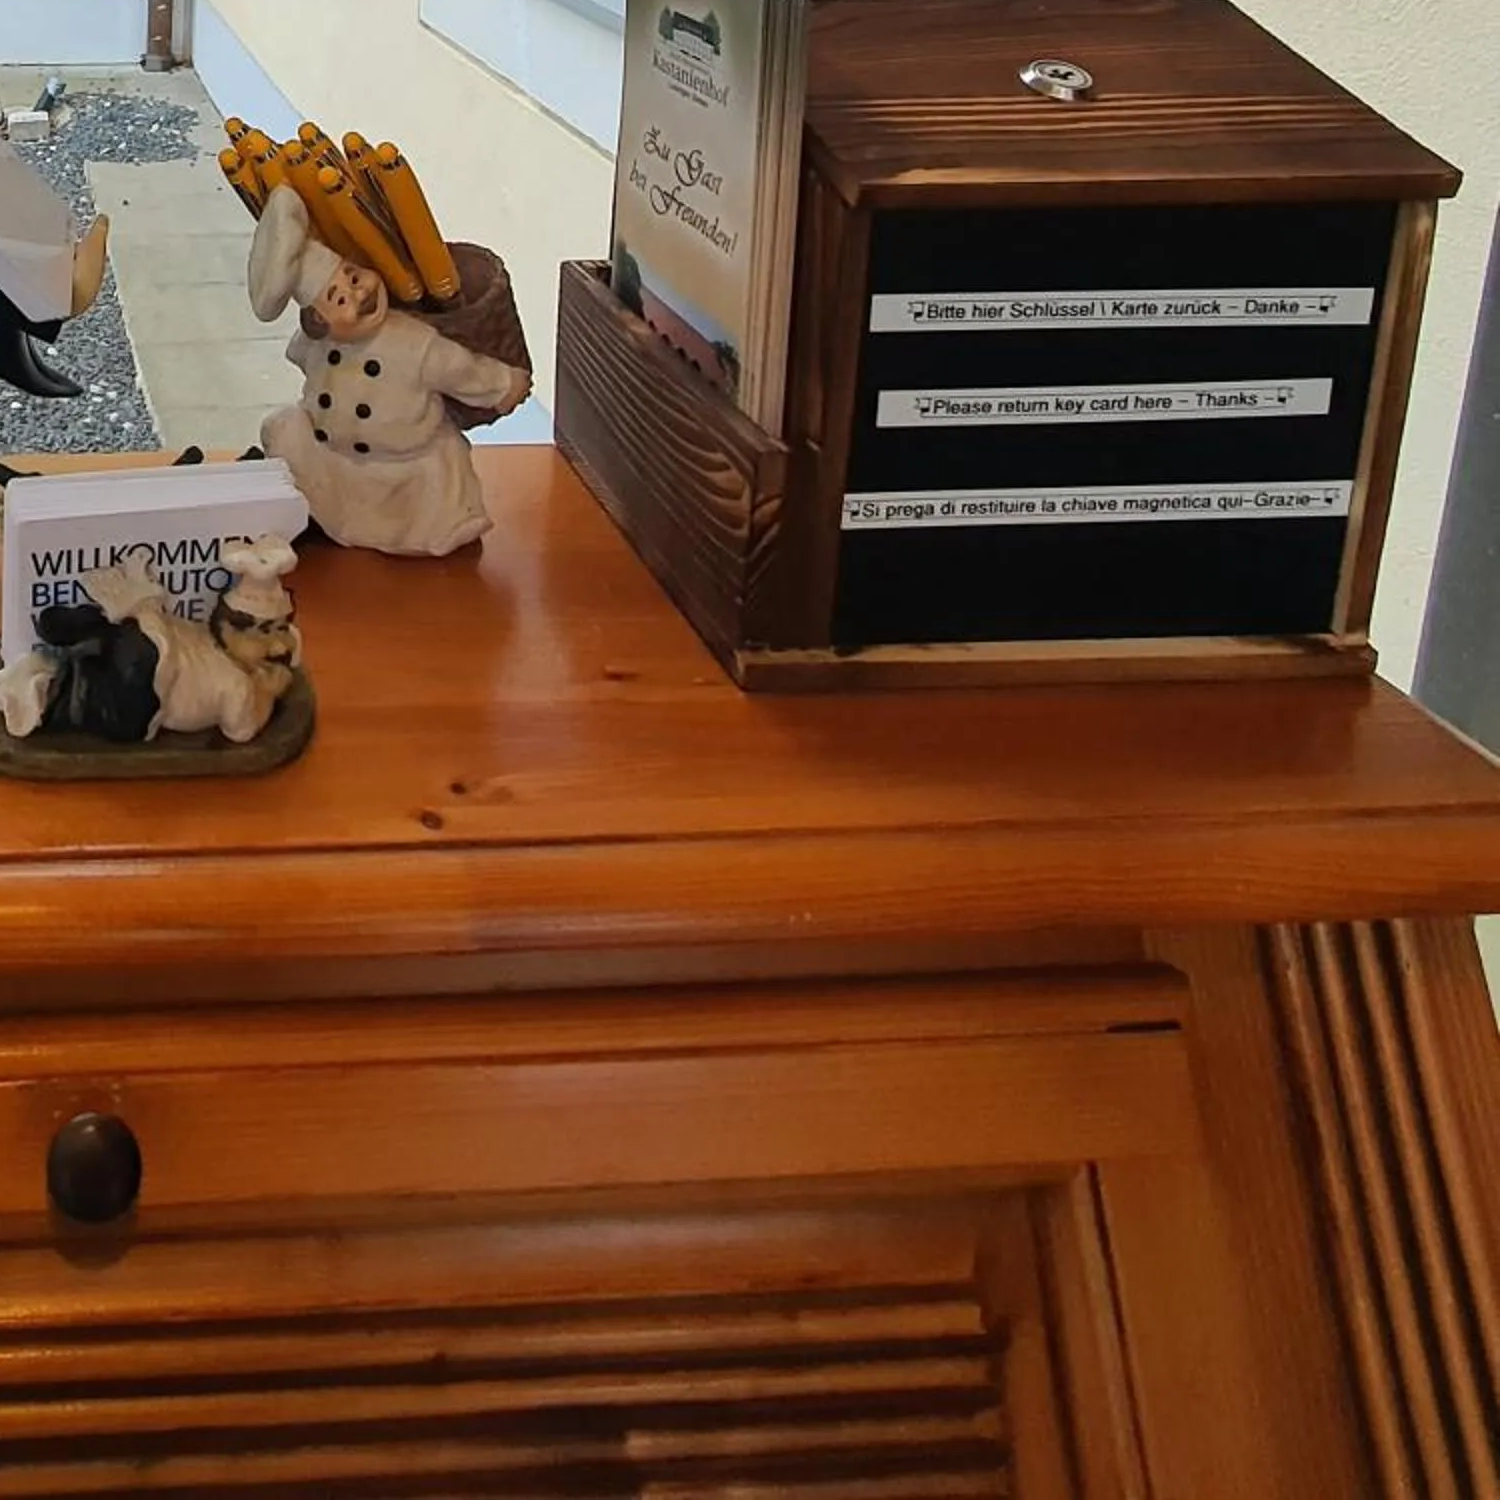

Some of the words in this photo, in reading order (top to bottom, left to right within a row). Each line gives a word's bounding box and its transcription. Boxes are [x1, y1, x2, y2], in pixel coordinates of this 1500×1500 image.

[927, 302, 966, 321] Bitte
[971, 301, 1004, 319] hier
[1010, 299, 1095, 318] Schlüssel
[1112, 299, 1159, 317] Karte
[1163, 299, 1221, 316] zurück
[1244, 299, 1299, 315] Danke
[933, 398, 992, 415] Please
[997, 397, 1049, 414] return
[1054, 396, 1085, 416] key
[1090, 394, 1128, 412] card
[1133, 393, 1173, 411] here
[1195, 391, 1258, 408] Thanks
[861, 502, 881, 518] Si
[886, 504, 935, 522] prega
[941, 500, 956, 516] di
[961, 498, 1036, 516] restituire
[1041, 497, 1057, 513] la
[1062, 495, 1119, 513] chiave
[1123, 493, 1211, 514] magnetica
[31, 534, 256, 577] WILLKOMM
[31, 566, 234, 608] BENUTO
